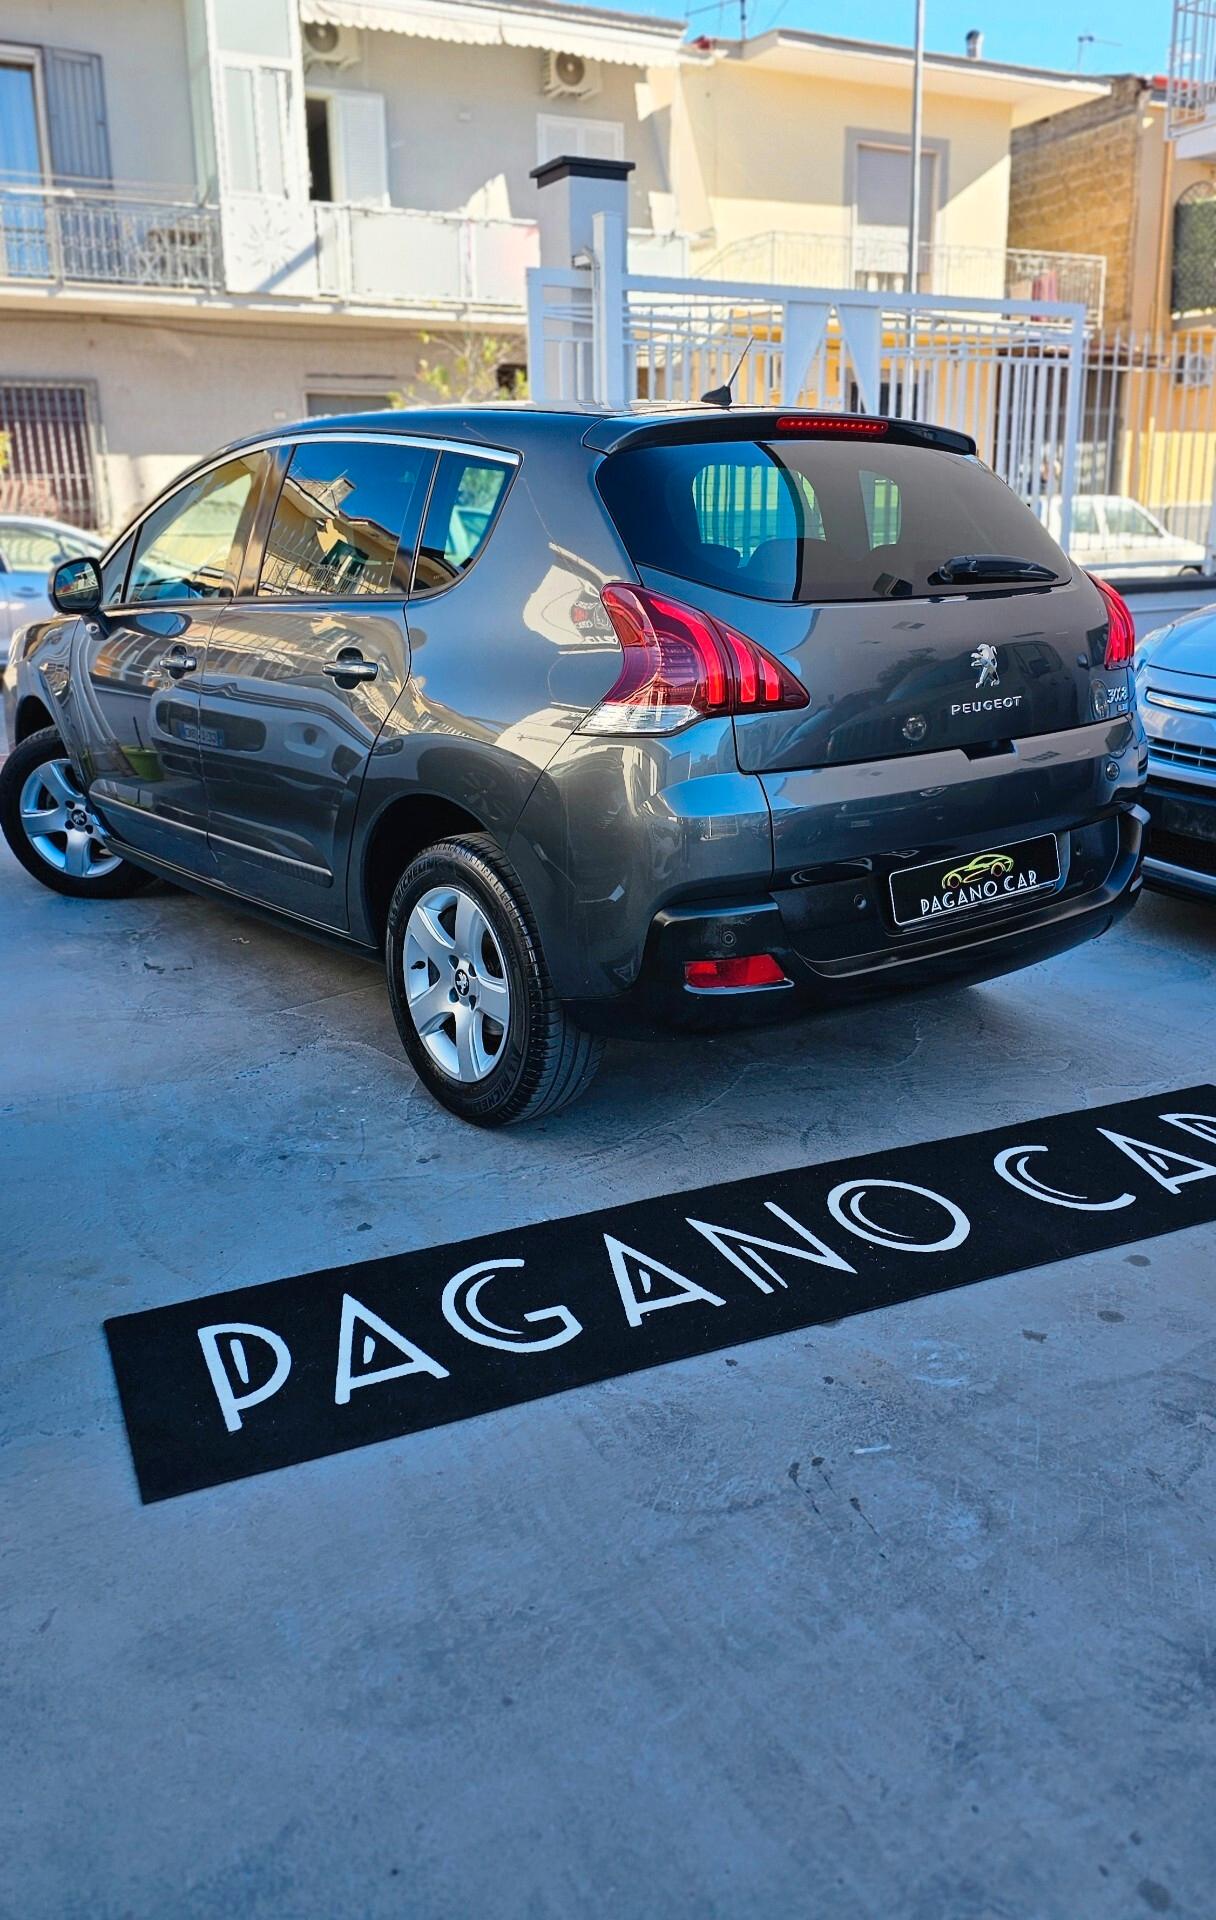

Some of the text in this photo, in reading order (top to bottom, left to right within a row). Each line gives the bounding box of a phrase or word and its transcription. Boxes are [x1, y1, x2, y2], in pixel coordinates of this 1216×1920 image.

[951, 696, 1022, 716] PEUGEOT
[920, 870, 1037, 915] PAGANO CAR
[197, 1178, 971, 1432] PAGANO
